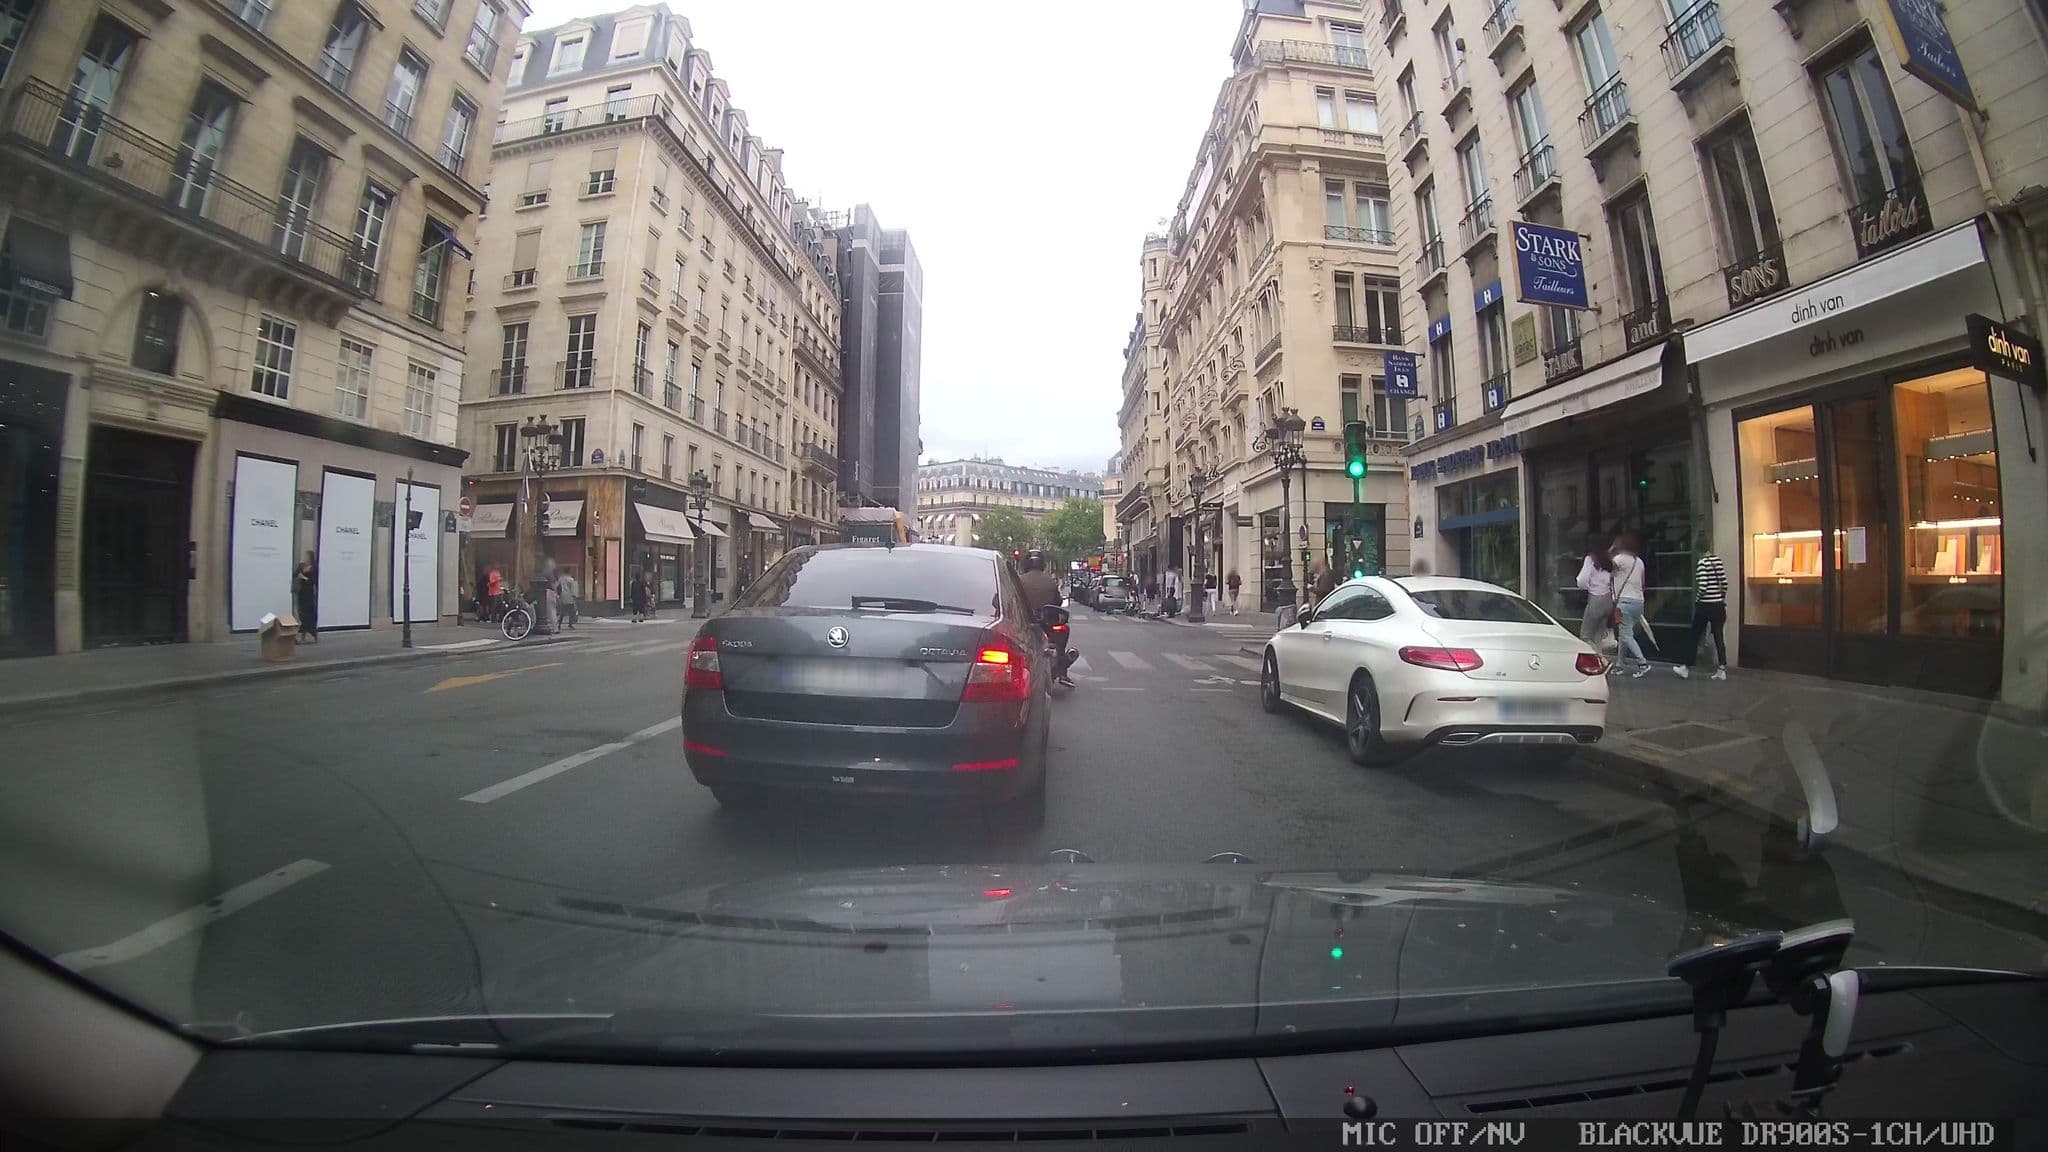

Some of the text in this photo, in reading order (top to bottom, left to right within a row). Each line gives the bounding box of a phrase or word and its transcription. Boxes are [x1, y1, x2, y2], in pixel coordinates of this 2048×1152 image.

[1516, 227, 1582, 265] STARK
[1538, 256, 1567, 271] SONS
[1533, 276, 1575, 295] Tailleurs
[1544, 196, 1920, 380] STARK and SONS tailors
[1791, 295, 1845, 324] dinh van
[1809, 328, 1864, 357] dinh van
[1988, 326, 2031, 365] dinh van
[251, 518, 279, 528] CHANEL
[336, 526, 360, 534] CHANEL
[920, 647, 967, 656] OCTAVIA
